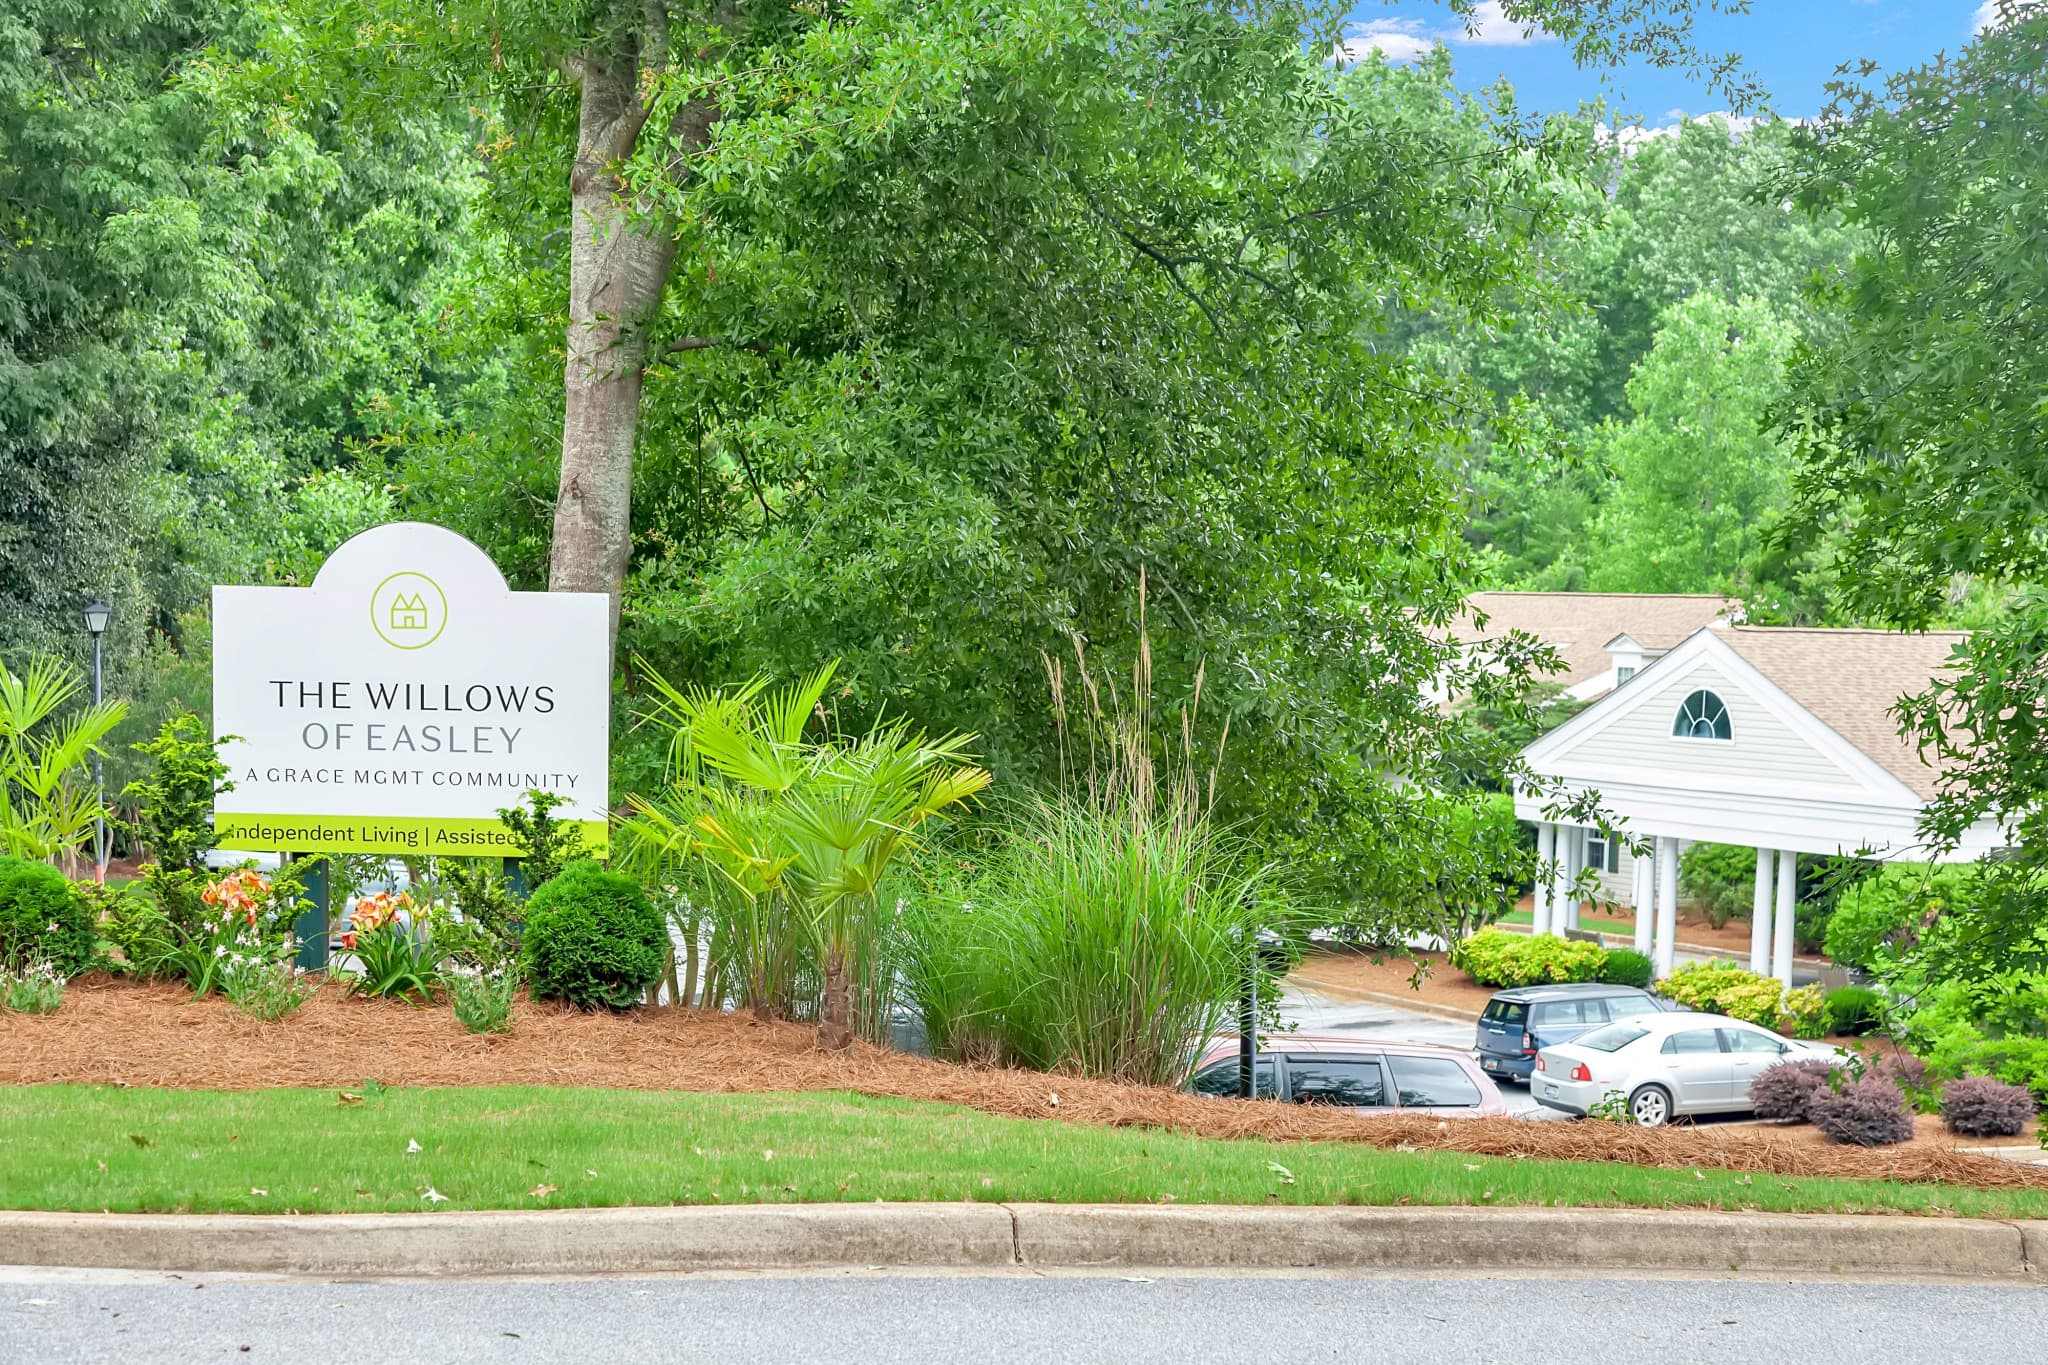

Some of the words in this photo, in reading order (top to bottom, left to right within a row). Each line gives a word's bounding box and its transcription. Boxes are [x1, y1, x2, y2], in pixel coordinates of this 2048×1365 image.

[269, 680, 351, 709] THE
[365, 682, 555, 713] WILLOWS
[302, 722, 354, 750] OF
[367, 724, 522, 754] EASLEY
[246, 767, 258, 782] A
[266, 768, 344, 784] GRACE
[354, 770, 424, 786] MGMT
[432, 771, 579, 788] COMMUNITY
[362, 826, 419, 846] Living
